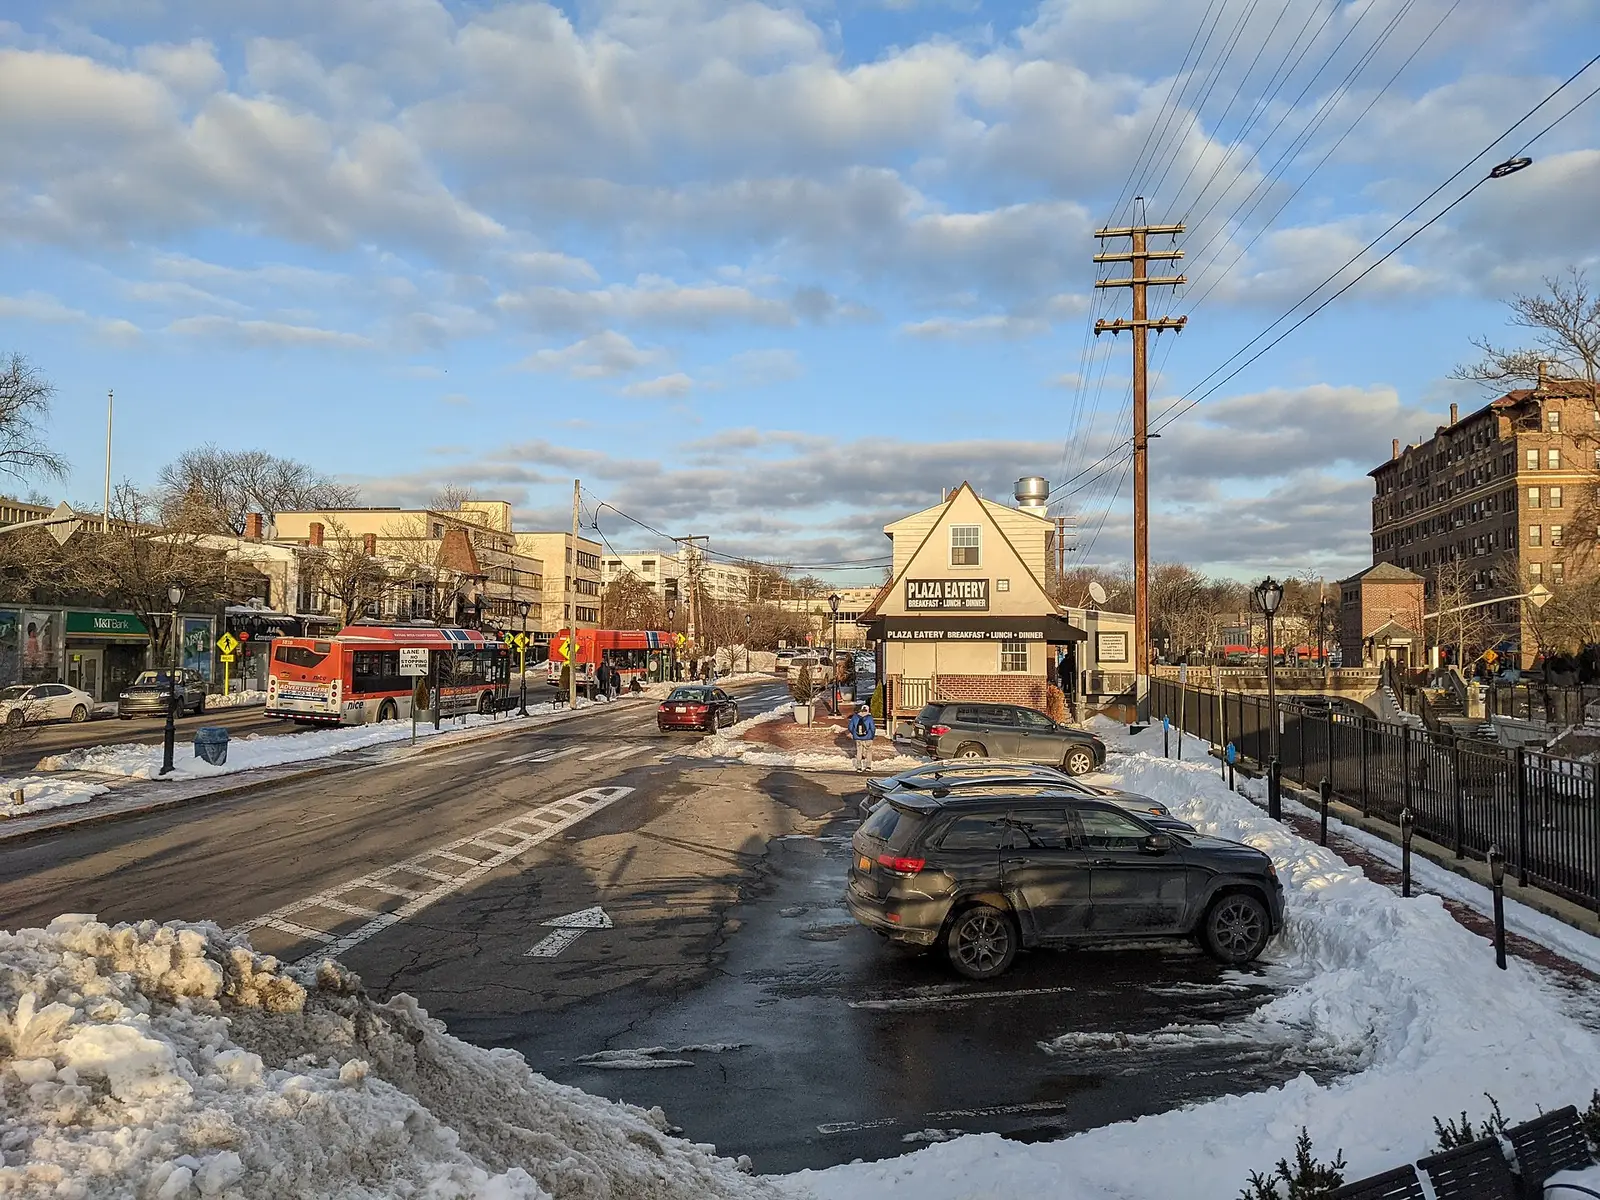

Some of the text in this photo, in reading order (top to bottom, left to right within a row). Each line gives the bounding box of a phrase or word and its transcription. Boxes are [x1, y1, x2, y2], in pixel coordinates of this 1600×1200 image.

[908, 581, 985, 598] PLAZA EATERY
[908, 599, 985, 607] BREAKFAST LUNCH DINNER
[93, 617, 129, 629] M&T Bank
[887, 631, 1043, 639] PLAZA EATERY BREAKFAST LUNCH DINNER
[347, 701, 364, 710] nice
